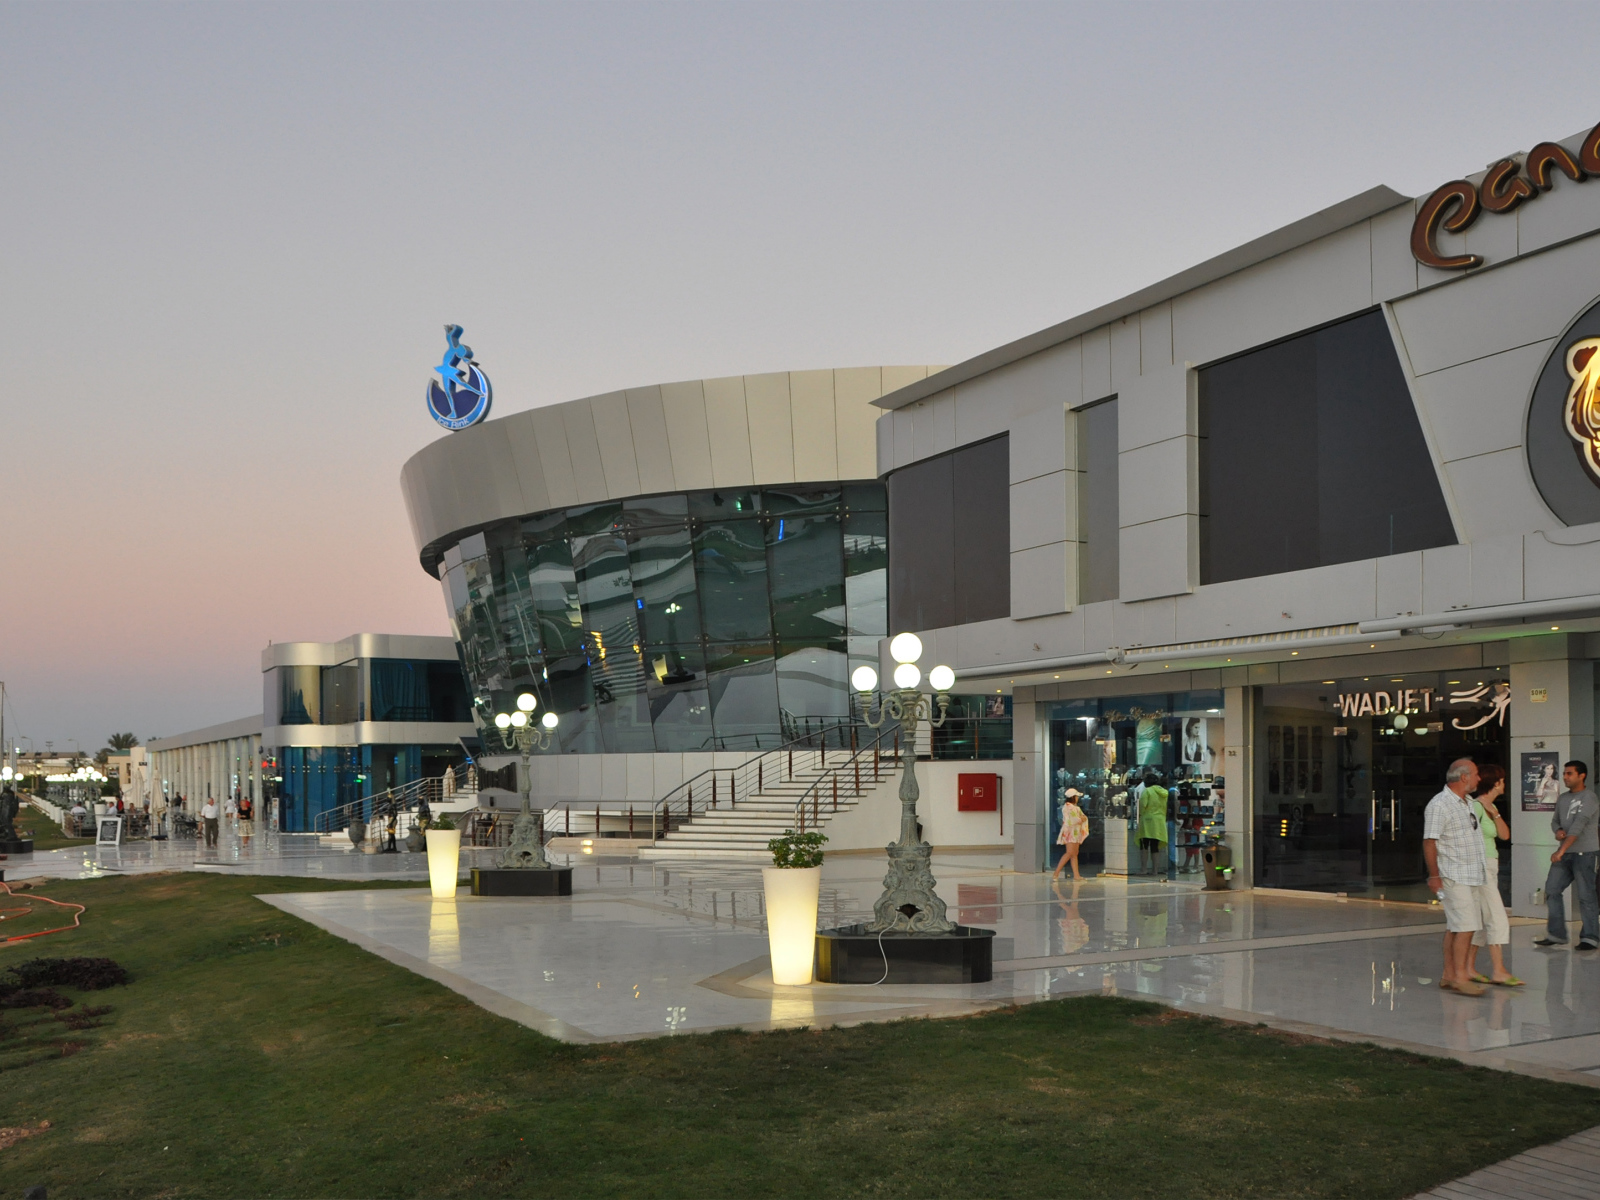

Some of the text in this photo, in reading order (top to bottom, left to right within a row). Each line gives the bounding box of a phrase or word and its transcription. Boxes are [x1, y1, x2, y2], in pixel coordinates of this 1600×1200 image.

[437, 416, 470, 428] Ice Rink
[1338, 688, 1436, 718] WADJET
